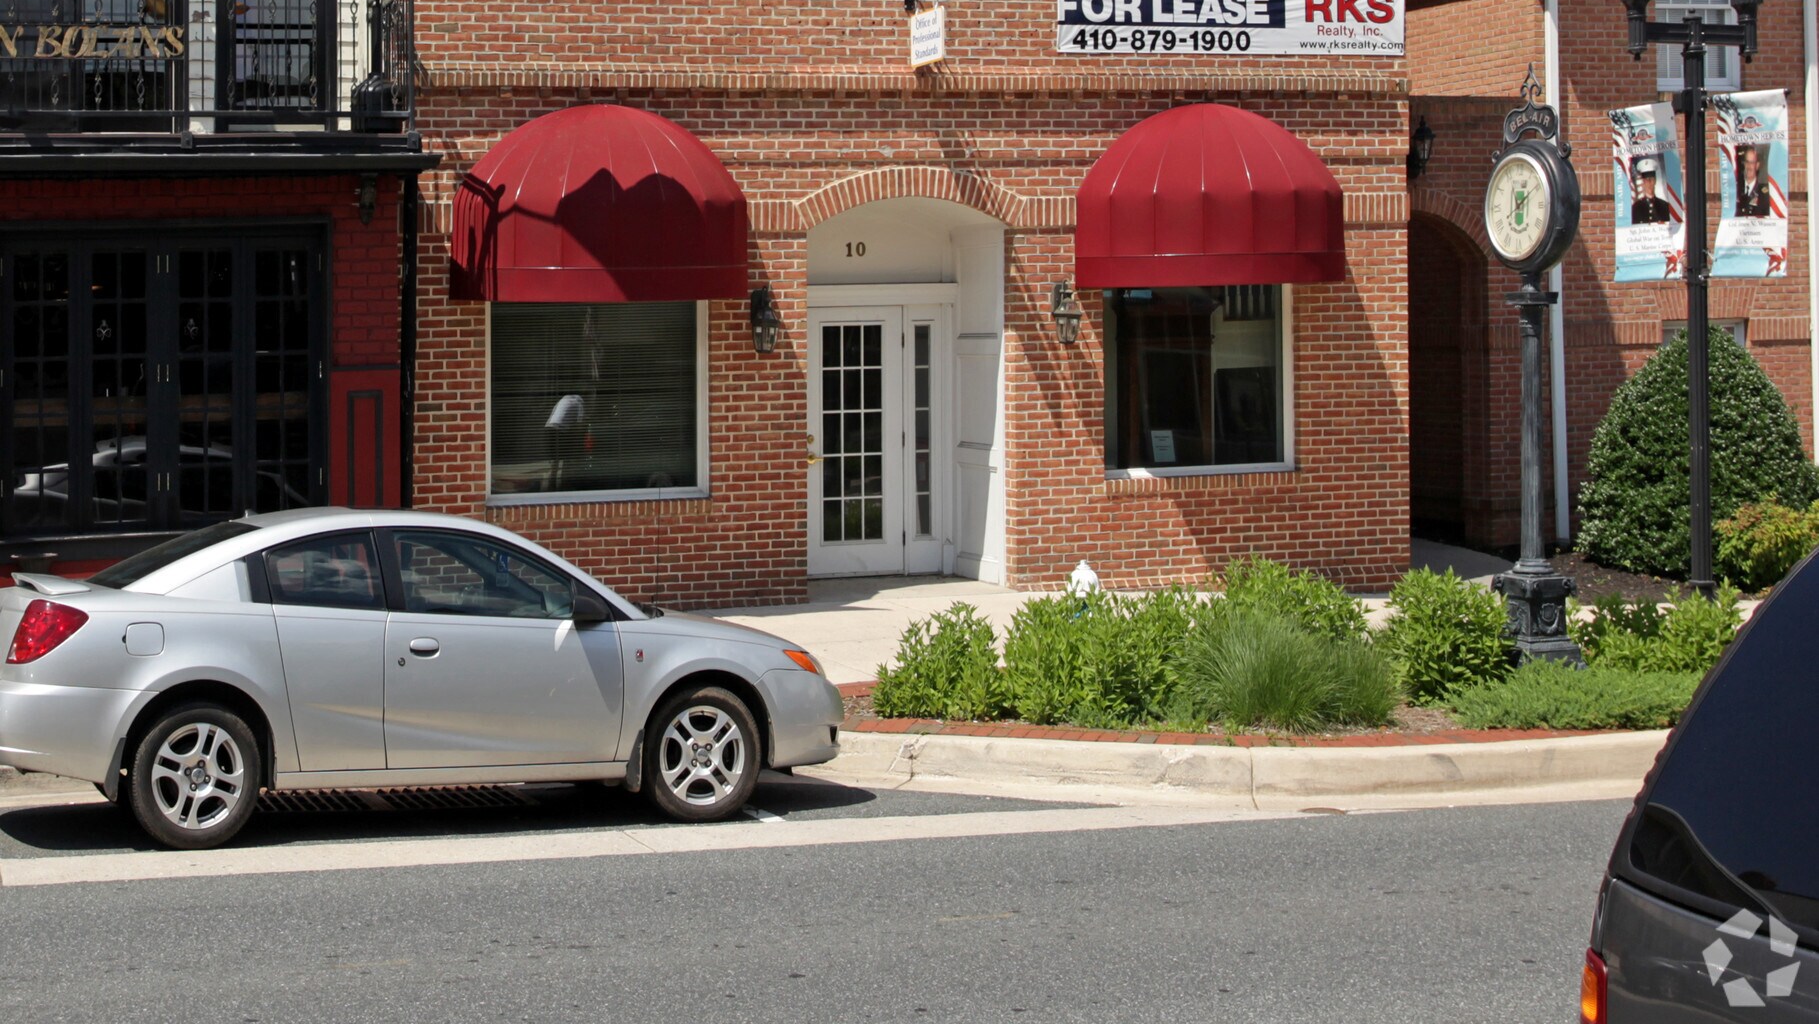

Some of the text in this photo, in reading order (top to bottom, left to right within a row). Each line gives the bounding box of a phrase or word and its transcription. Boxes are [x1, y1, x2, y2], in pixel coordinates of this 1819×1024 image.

[915, 10, 938, 30] Office of
[1317, 25, 1383, 38] Realty, Inc.
[34, 25, 185, 59] BOLANS
[1072, 28, 1251, 52] 410-879-1900
[1299, 39, 1404, 51] www.rksrealty.com
[1720, 132, 1760, 143] HOMETOWN
[845, 241, 867, 257] 10
